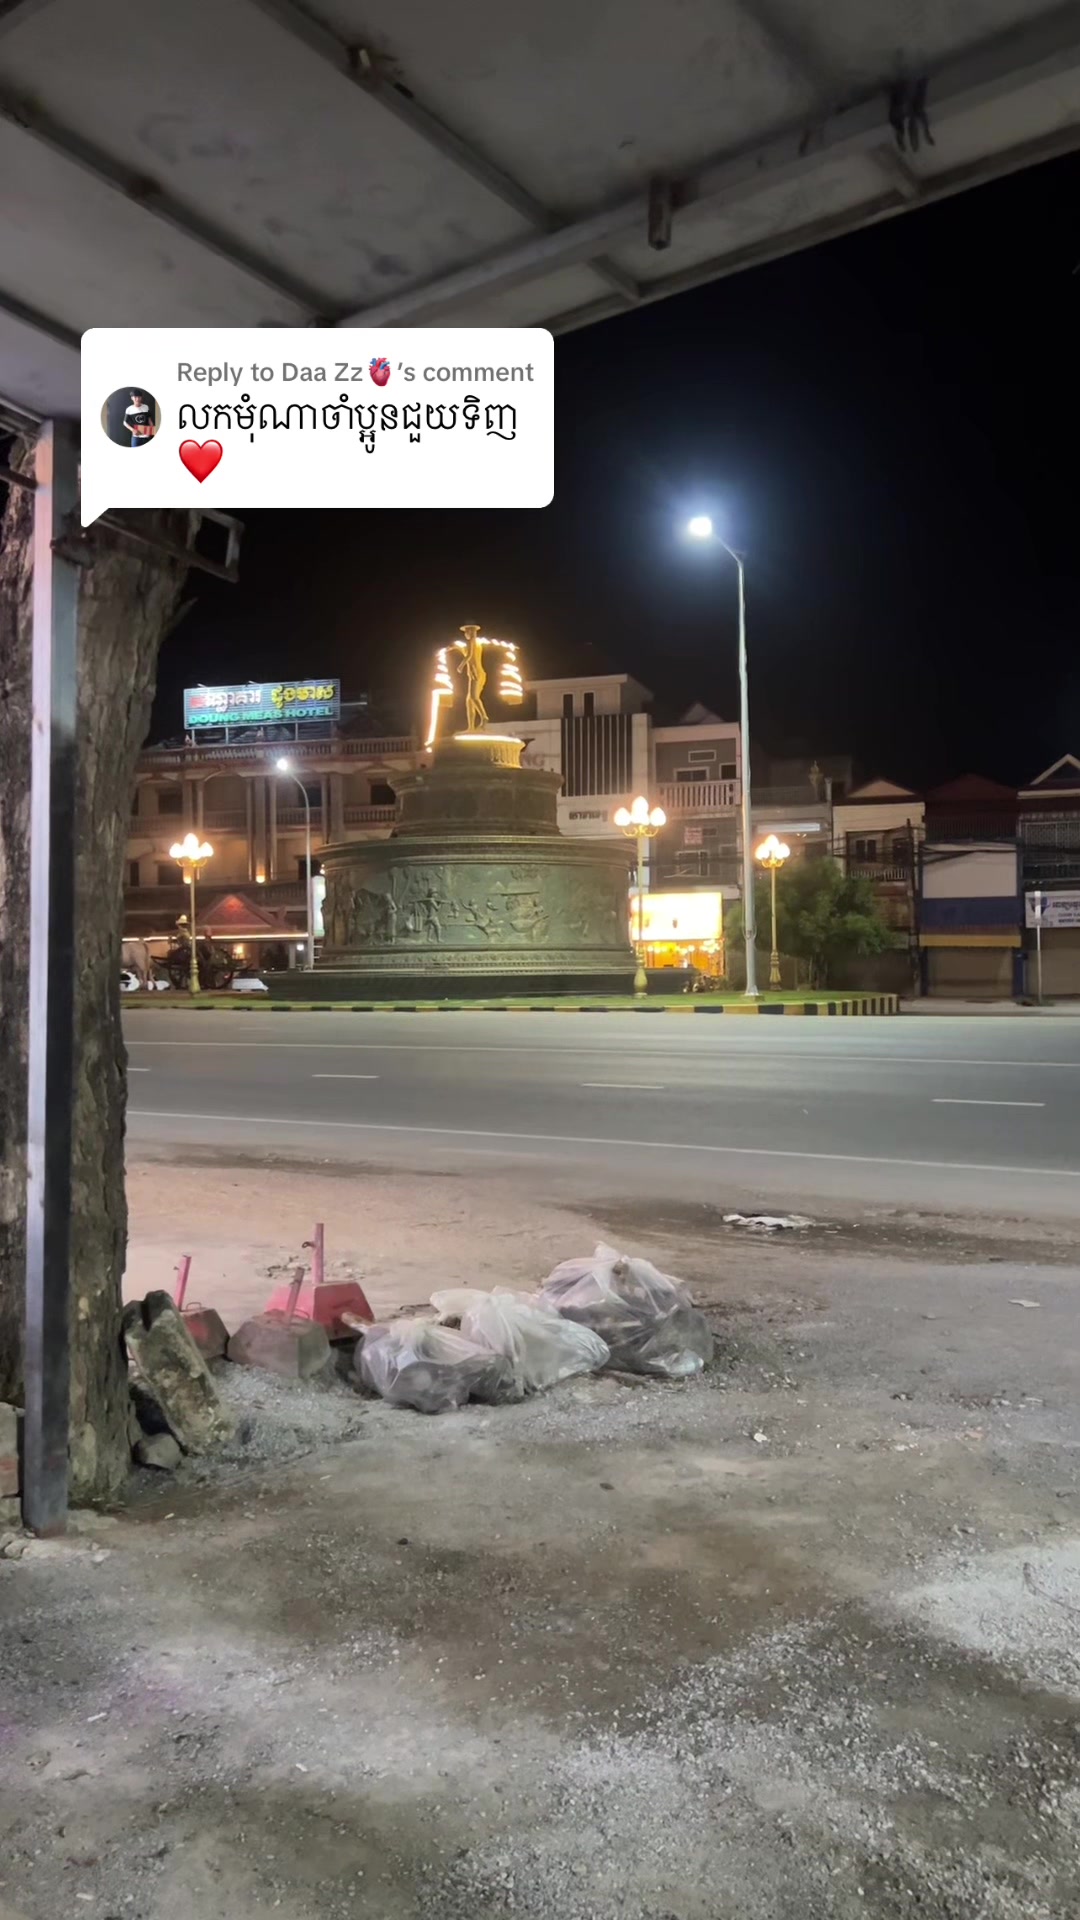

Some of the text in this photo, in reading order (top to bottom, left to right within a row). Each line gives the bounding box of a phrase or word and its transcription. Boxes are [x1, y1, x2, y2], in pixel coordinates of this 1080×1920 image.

[188, 706, 334, 725] DOUNG MEAS HOTEL
